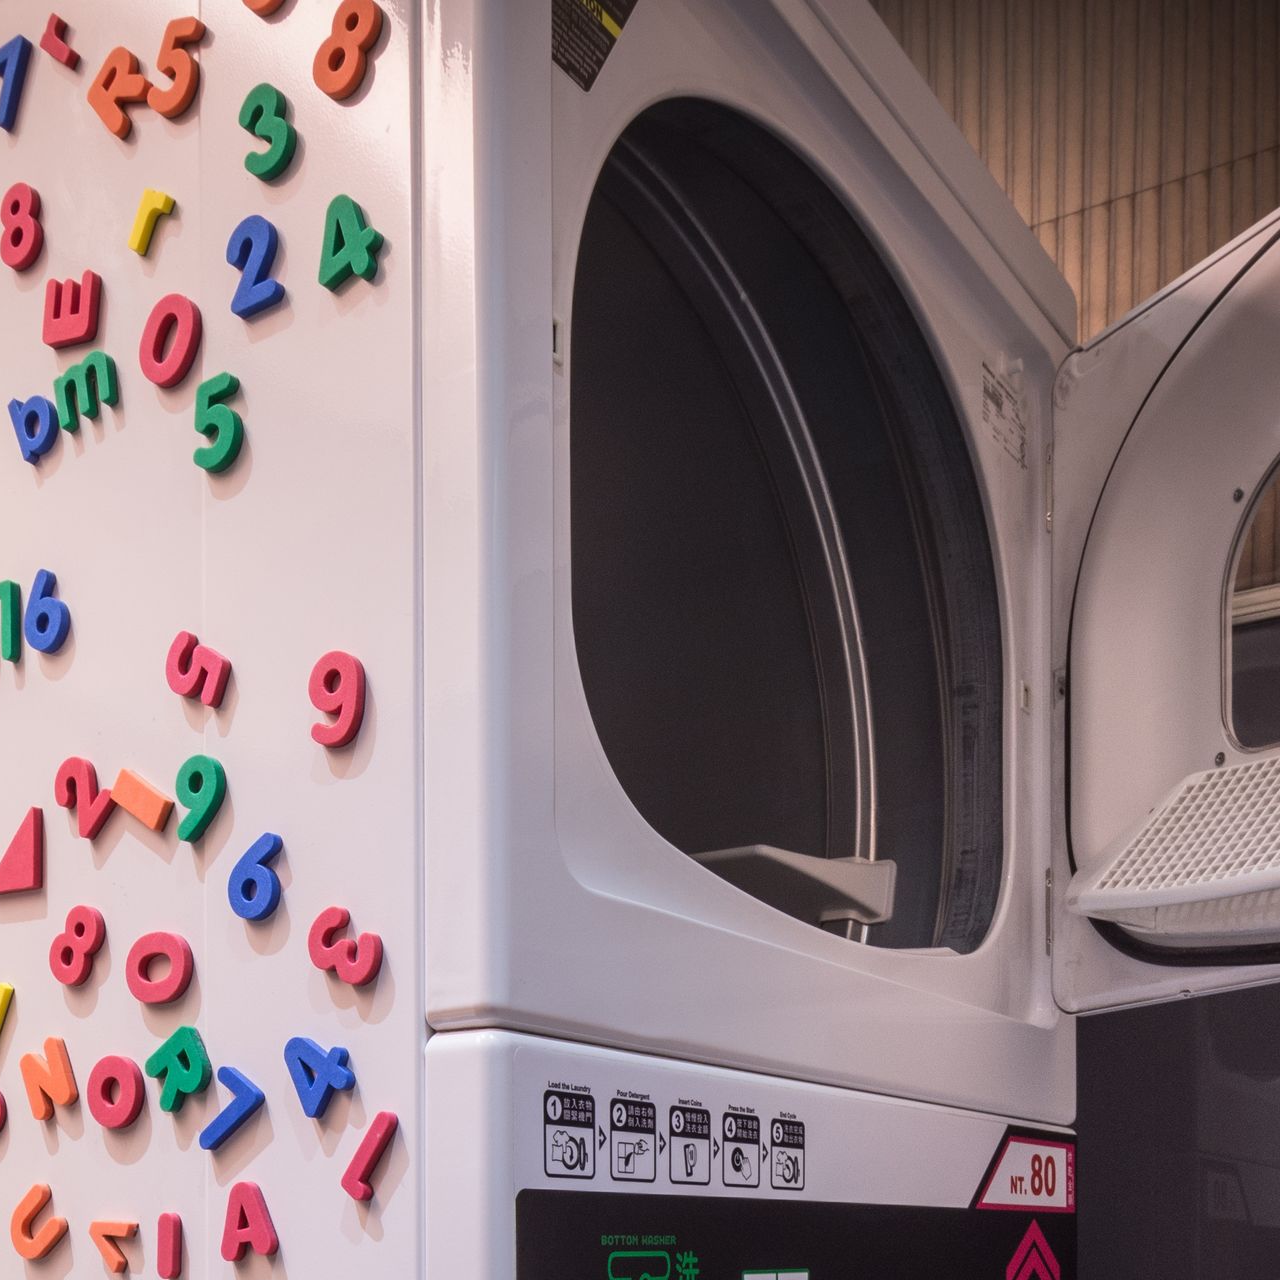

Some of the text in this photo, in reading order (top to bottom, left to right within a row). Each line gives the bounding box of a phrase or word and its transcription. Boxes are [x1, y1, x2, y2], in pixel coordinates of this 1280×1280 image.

[147, 16, 207, 119] 5
[313, 0, 384, 101] 8
[239, 82, 297, 181] 3
[0, 182, 44, 272] 8
[226, 214, 285, 320] 2
[319, 194, 384, 291] 4
[193, 371, 244, 474] 5
[308, 650, 366, 749] 9
[227, 832, 284, 921] 6
[50, 905, 107, 988] 8
[548, 1081, 591, 1094] Load the Laundry
[617, 1089, 627, 1097] Pour
[220, 1181, 279, 1262] A
[1010, 1153, 1056, 1197] NT. 80
